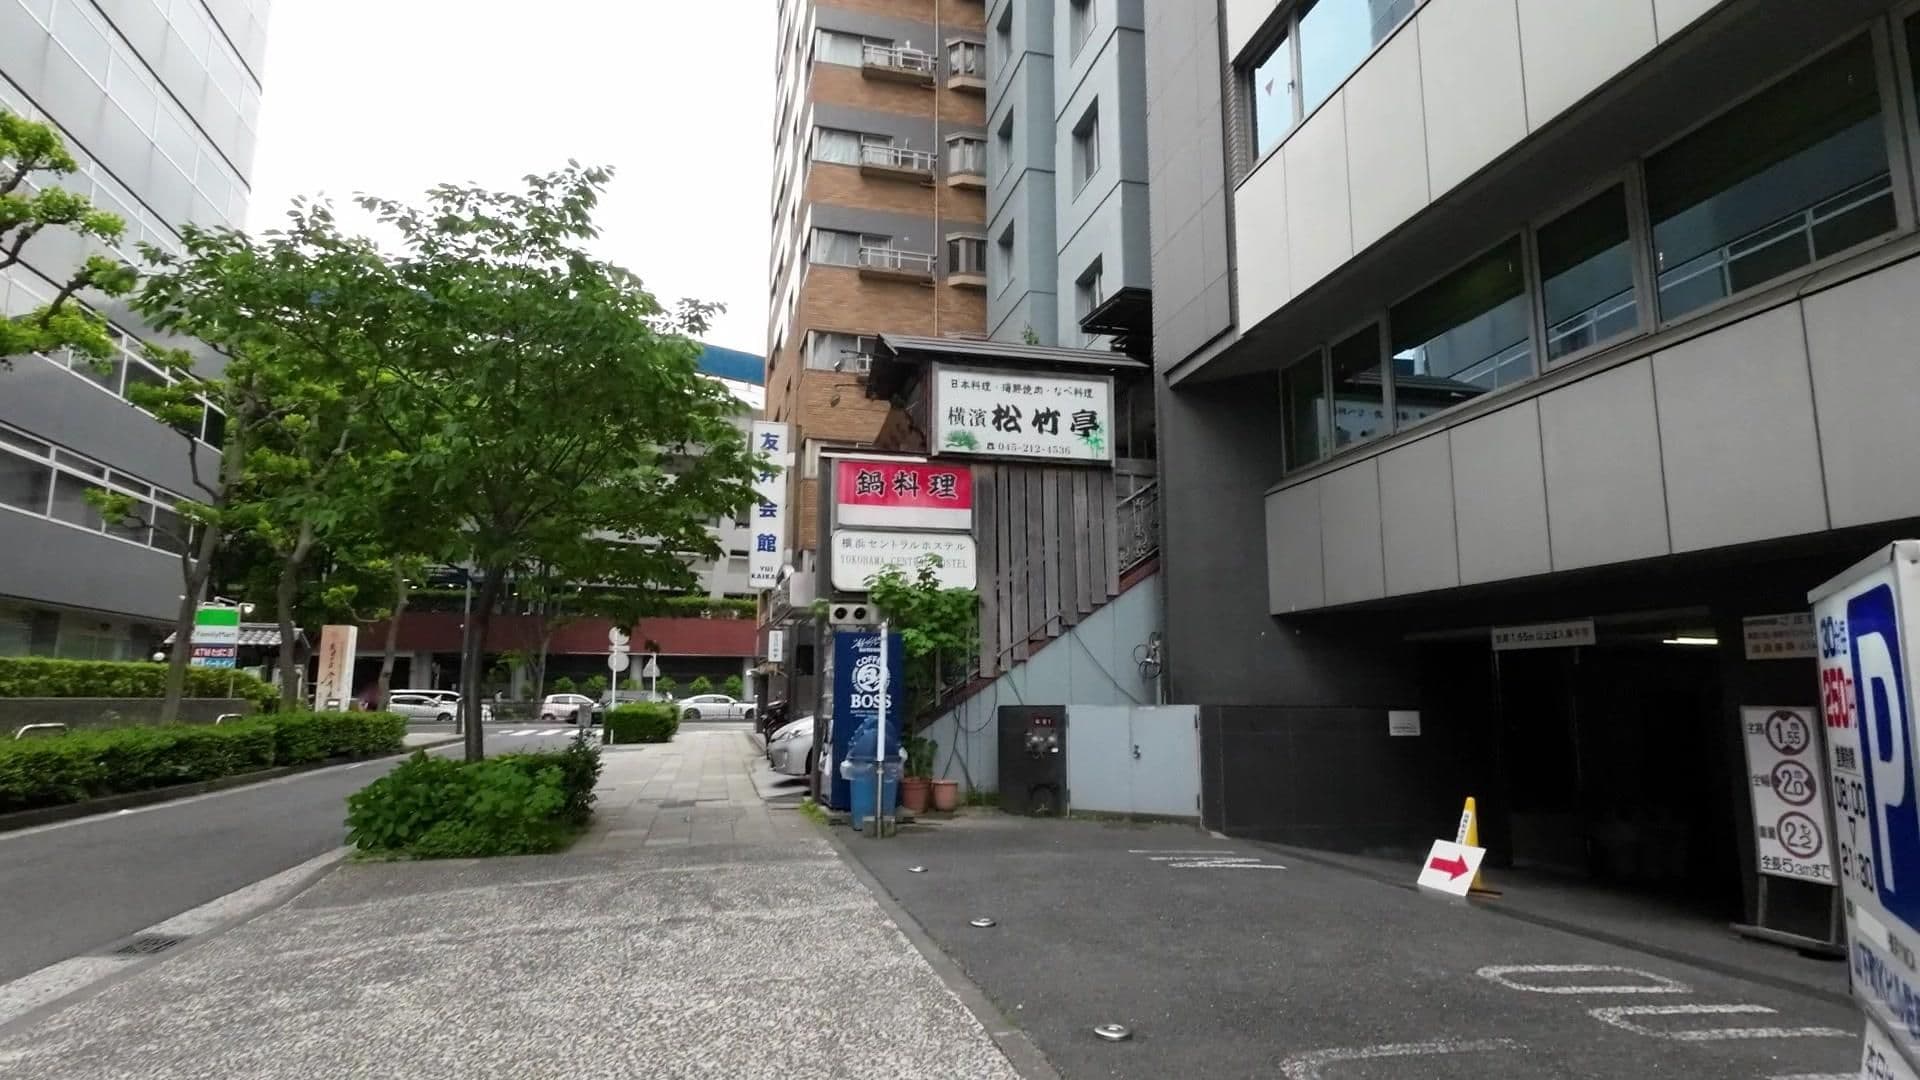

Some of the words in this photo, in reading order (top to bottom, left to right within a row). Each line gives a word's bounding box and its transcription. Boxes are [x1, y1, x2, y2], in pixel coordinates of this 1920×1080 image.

[991, 403, 1099, 437] 松竹亭
[997, 442, 1071, 455] 045-212-4536
[856, 469, 958, 499] 鍋料理
[842, 538, 967, 551] 横浜セントラルホステル
[841, 555, 885, 566] YOKOHAMA
[850, 694, 892, 708] BOSS
[1857, 632, 1905, 893] P
